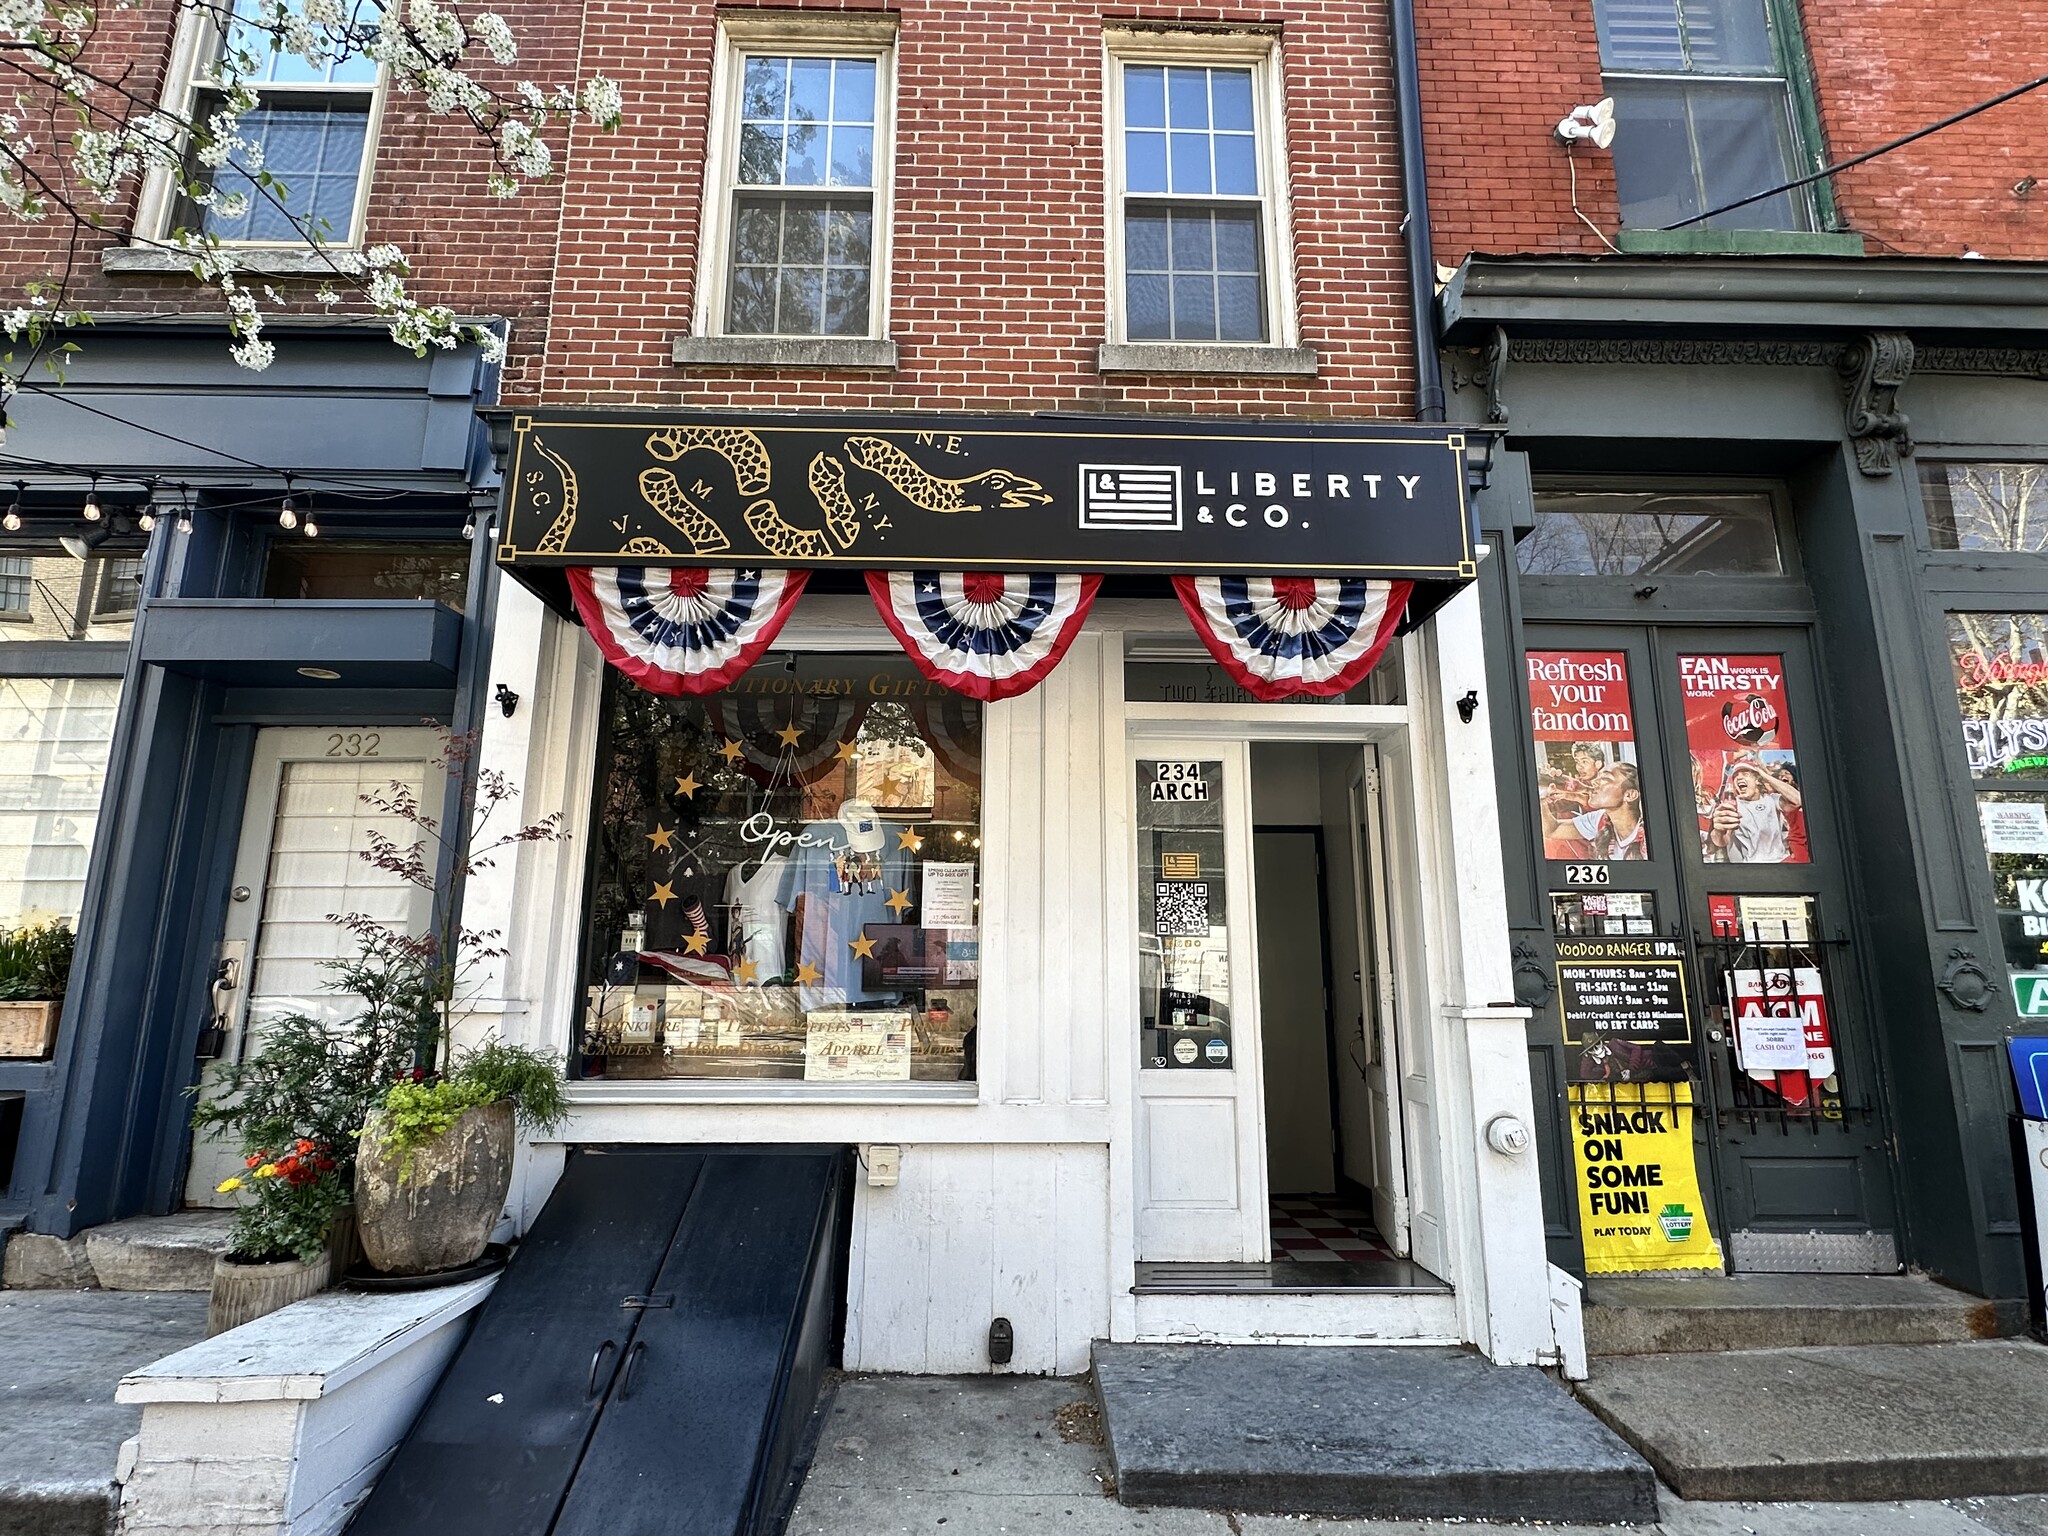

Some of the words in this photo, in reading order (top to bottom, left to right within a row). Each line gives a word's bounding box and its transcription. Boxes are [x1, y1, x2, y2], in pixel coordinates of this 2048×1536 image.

[1196, 471, 1421, 499] LIBERTY
[1527, 657, 1623, 681] Refresh
[1681, 658, 1729, 674] FAN
[868, 673, 949, 696] GIFTS
[1682, 675, 1780, 690] THIRSTY
[1550, 684, 1606, 707] your
[1532, 707, 1629, 731] fandom
[325, 733, 381, 757] 232
[1159, 763, 1199, 781] 234
[1152, 782, 1208, 800] ARCH
[740, 812, 850, 864] Open
[1567, 865, 1608, 883] 236
[1556, 942, 1603, 956] VOODOO
[1607, 942, 1652, 956] RANGER
[1654, 943, 1677, 956] IPA
[1563, 969, 1627, 979] MON-THURS:
[1628, 969, 1646, 978] 8AM
[1656, 969, 1677, 978] 10PM
[1575, 982, 1617, 991] FRI-SAT:
[1620, 982, 1637, 991] 8AM
[1647, 982, 1669, 991] 11PM
[1579, 995, 1623, 1005] SUNDAY:
[1625, 995, 1642, 1005] 9AM
[1652, 995, 1669, 1005] 9PM
[1595, 1021, 1609, 1030] NO
[1611, 1021, 1627, 1030] EBT
[1631, 1021, 1660, 1030] CARDS
[818, 1041, 884, 1055] APPAREL
[1584, 1139, 1623, 1161] ON
[1586, 1164, 1663, 1189] SOME
[1589, 1191, 1650, 1216] FUN!
[1594, 1227, 1615, 1236] PLAY
[1617, 1226, 1652, 1236] TODAY
